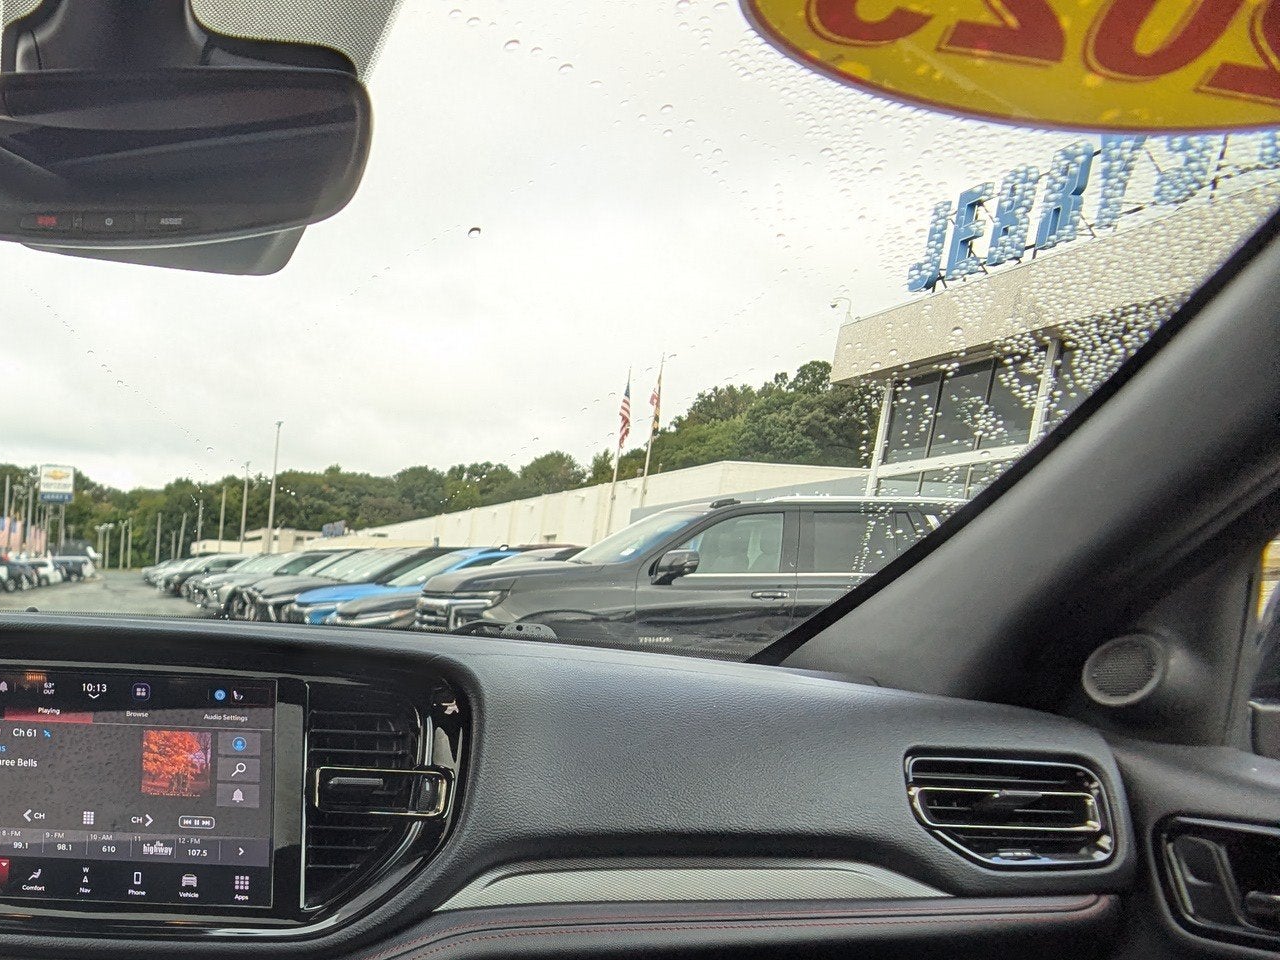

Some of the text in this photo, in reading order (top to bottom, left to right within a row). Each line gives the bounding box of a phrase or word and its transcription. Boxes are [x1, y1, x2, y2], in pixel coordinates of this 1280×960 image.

[82, 683, 107, 693] 10:13
[38, 707, 61, 715] Playing
[204, 713, 248, 722] Audio Settings
[12, 728, 37, 738] Ch 61
[17, 758, 38, 767] Bells
[33, 812, 45, 820] CH
[131, 816, 143, 824] CH
[13, 841, 29, 849] 99.1
[57, 843, 72, 851] 98.1
[102, 845, 116, 853] 610
[143, 844, 173, 855] highway
[188, 849, 208, 857] 107.5
[22, 884, 45, 892] Comfort
[179, 891, 199, 899] Vehicle
